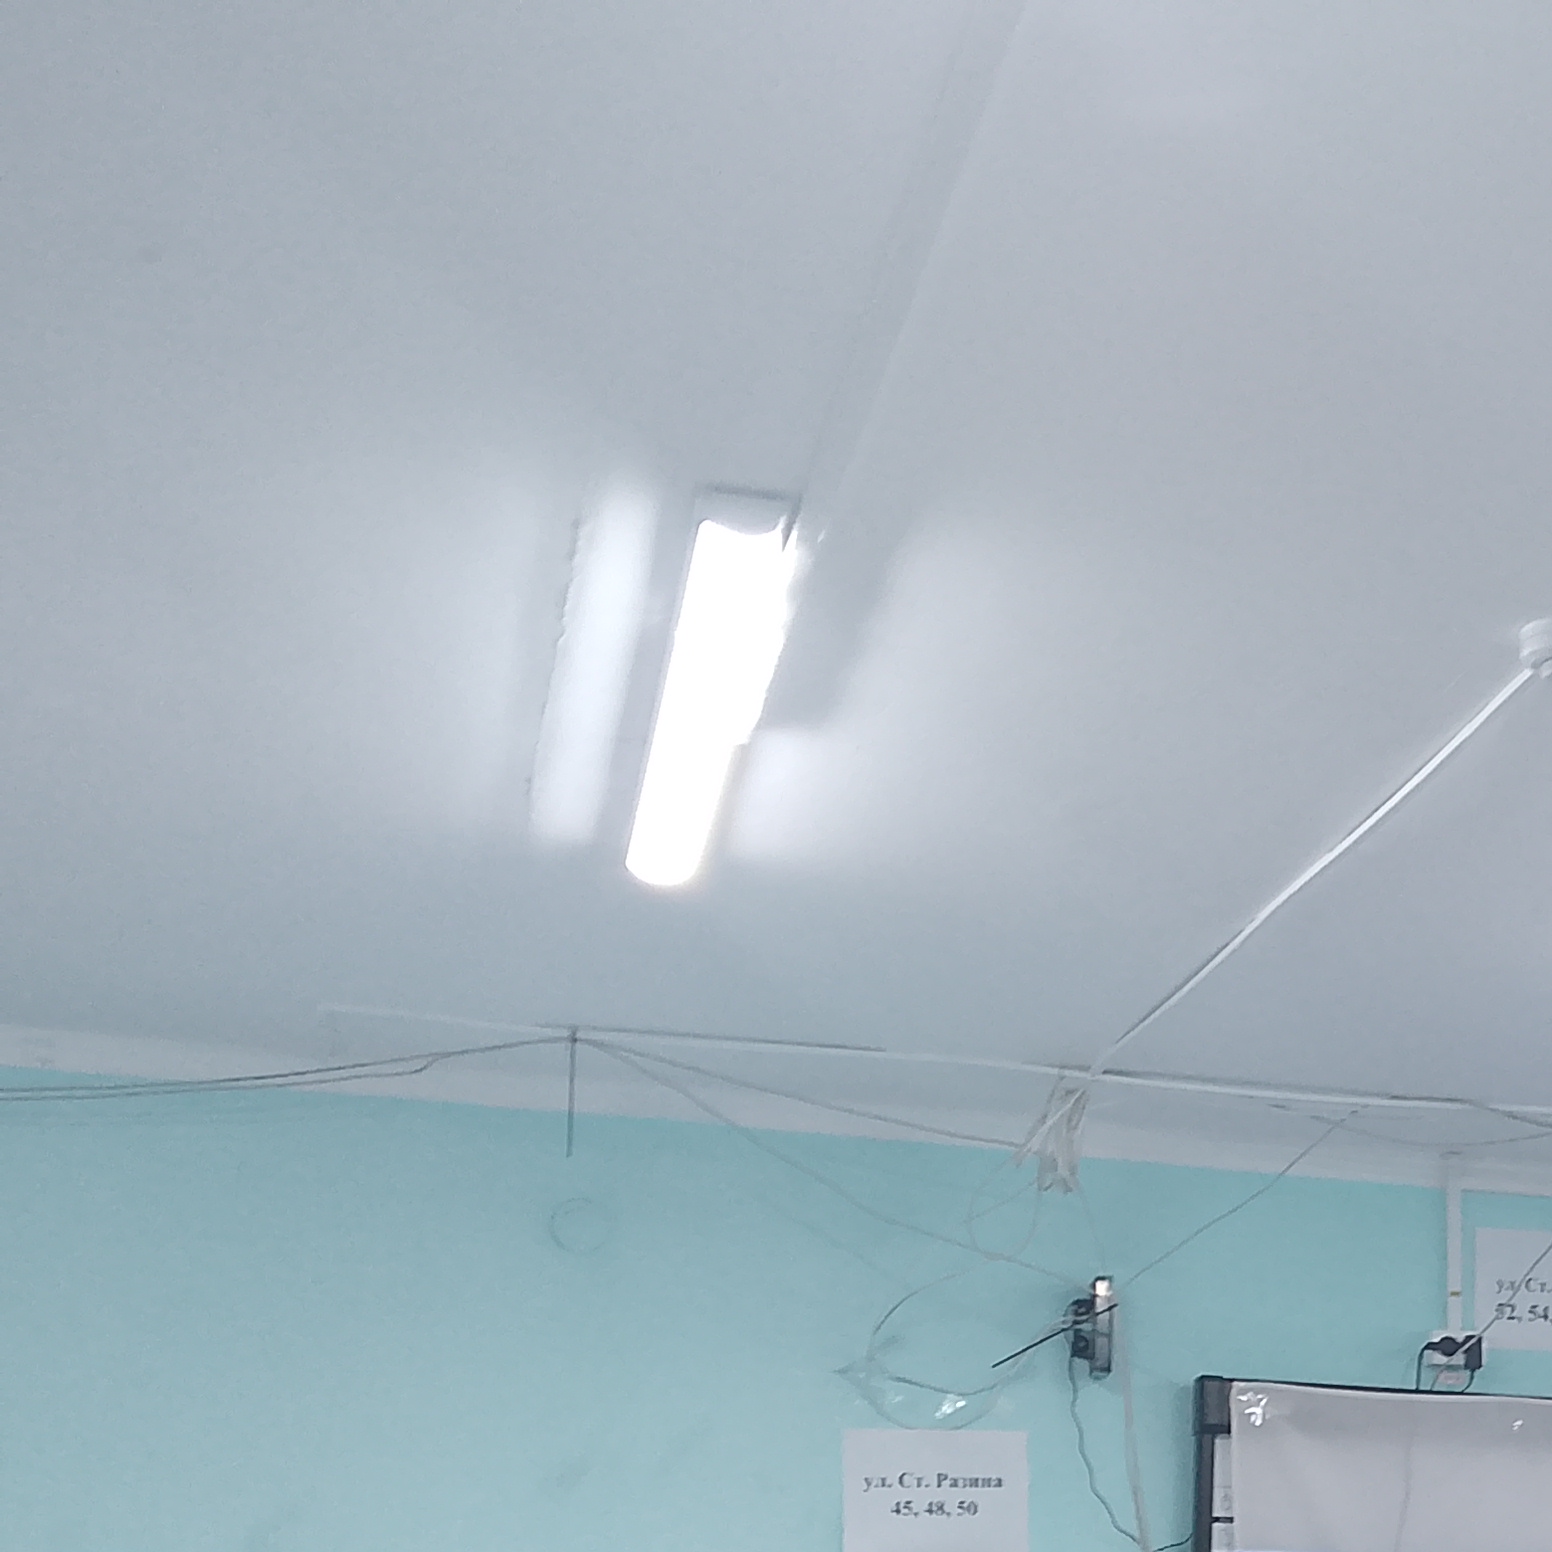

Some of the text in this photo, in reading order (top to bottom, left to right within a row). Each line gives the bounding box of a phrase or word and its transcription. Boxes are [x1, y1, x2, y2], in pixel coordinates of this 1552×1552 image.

[1525, 1277, 1552, 1294] Ст.
[862, 1472, 1003, 1492] ул. Ст. Разина
[890, 1500, 979, 1518] 45, 48, 50
